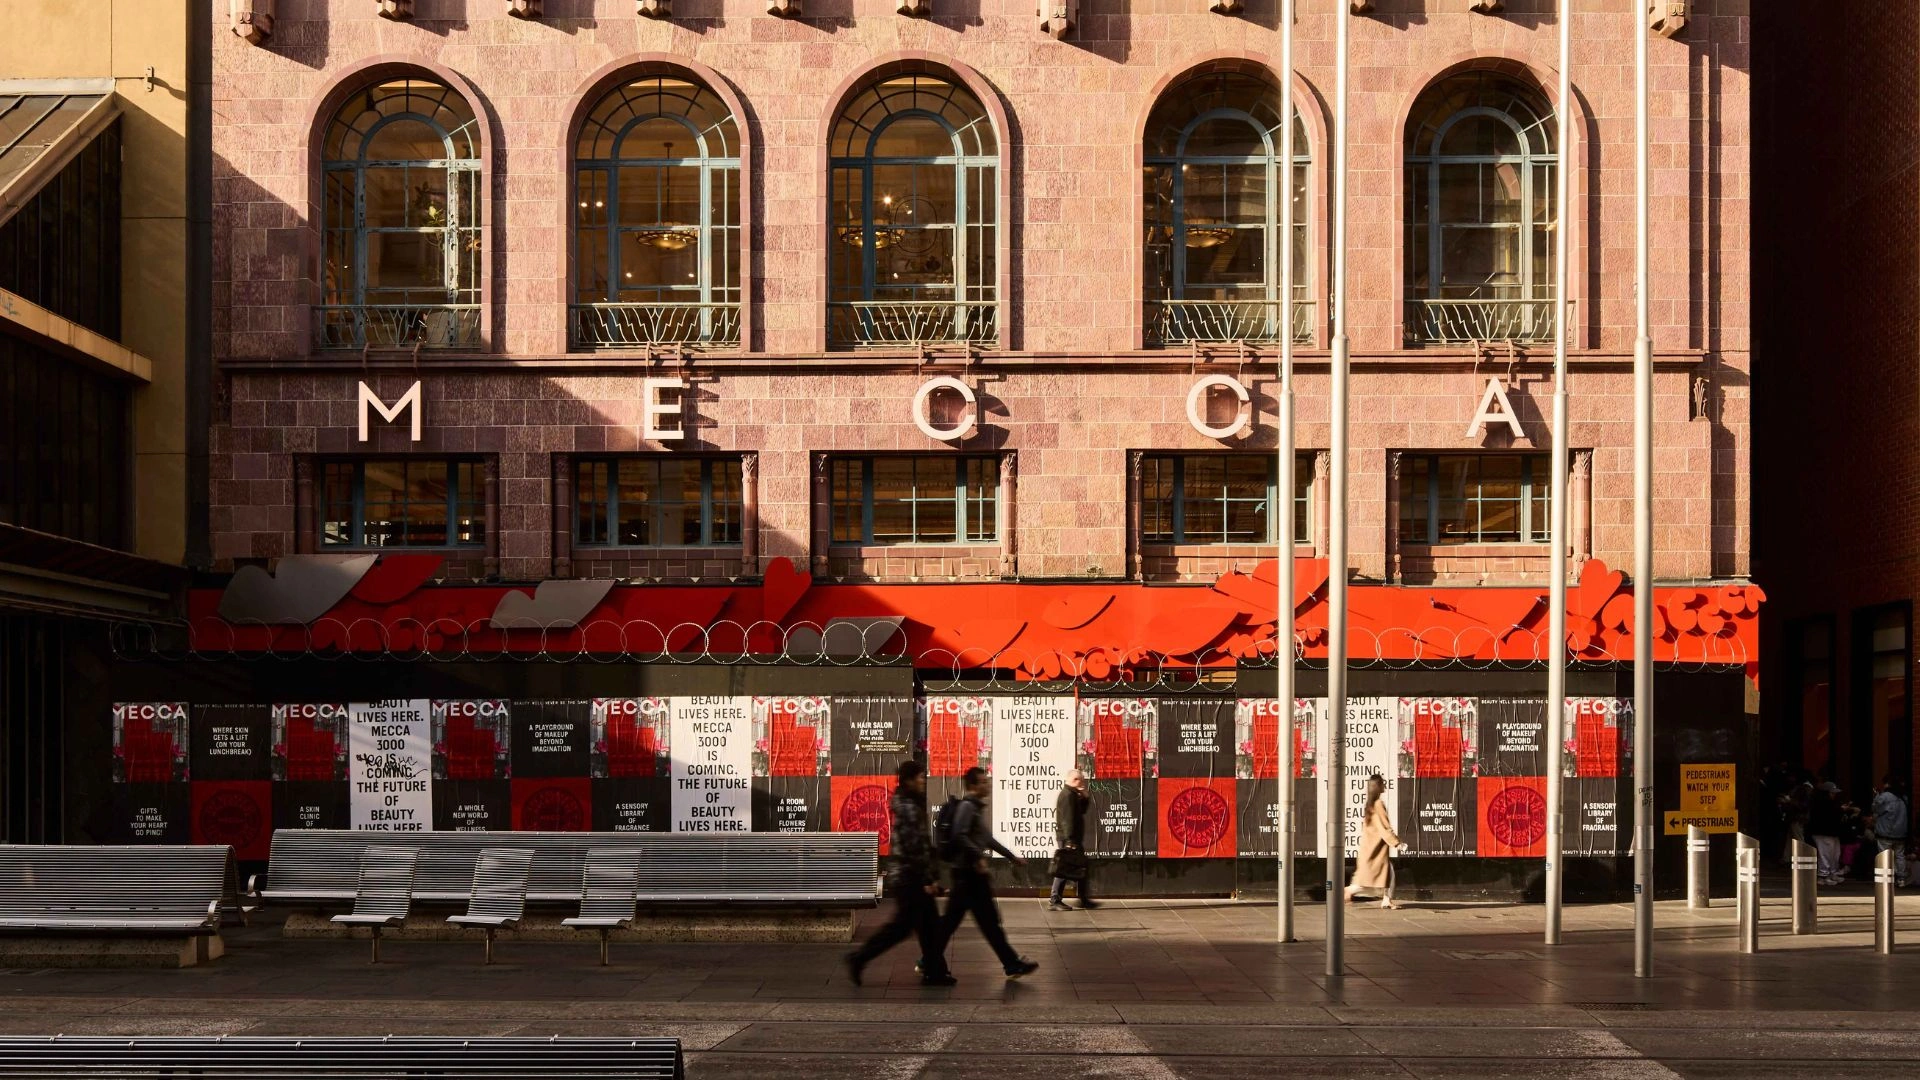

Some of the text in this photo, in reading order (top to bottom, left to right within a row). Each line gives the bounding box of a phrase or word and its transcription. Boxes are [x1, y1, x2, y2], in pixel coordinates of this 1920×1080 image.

[369, 699, 411, 708] BEAUTY
[691, 696, 733, 705] BEAUTY
[1013, 696, 1056, 706] BEAUTY
[1345, 697, 1380, 706] EAUTY
[272, 704, 348, 717] MECCA
[432, 702, 508, 716] MECCA
[593, 700, 669, 715] MECCA
[754, 699, 830, 714] MECCA
[915, 700, 992, 714] MECCA
[1080, 701, 1157, 715] MECCA
[1238, 701, 1314, 715] MECA
[1400, 701, 1477, 715] MECCA
[1564, 700, 1633, 714] MECCA
[112, 705, 187, 719] MECCA
[356, 711, 424, 723] LIVES HERE.
[679, 708, 746, 719] LIVES HERE.
[1001, 709, 1069, 719] LIVES HERE.
[1361, 709, 1393, 719] HERE.
[371, 726, 410, 736] MECCA
[693, 723, 732, 733] MECCA
[1015, 724, 1055, 734] MECCA
[376, 739, 405, 750] 3000
[698, 736, 727, 747] 3000
[1020, 738, 1049, 748] 3000
[1345, 738, 1373, 748] 3000
[386, 753, 396, 763] IS
[708, 750, 718, 760] IS
[1030, 752, 1039, 762] IS
[1354, 752, 1364, 762] IS
[367, 767, 416, 779] COMING.
[688, 765, 738, 775] COMING.
[1009, 766, 1060, 776] COMING.
[1686, 770, 1730, 779] PEDESTRIANS
[357, 781, 426, 793] THE FUTURE
[678, 778, 747, 789] THE FUTURE
[1000, 780, 1066, 790] THE FUTUR
[1687, 782, 1730, 792] WATCH YOUR
[384, 795, 399, 806] OF
[705, 792, 720, 803] OF
[1027, 794, 1041, 804] OF
[1353, 794, 1367, 804] OF
[1700, 795, 1716, 804] STEP
[1590, 802, 1617, 810] SENSORY
[371, 809, 414, 820] BEAUTY
[692, 806, 735, 817] BEAUTY
[1013, 808, 1057, 818] BEAUTY
[679, 820, 747, 831] LIVES HERE.
[1001, 822, 1031, 832] LIVES
[1682, 818, 1734, 828] PEDESTRIANS
[1014, 836, 1054, 846] MECCA
[1020, 850, 1048, 858] 3000
